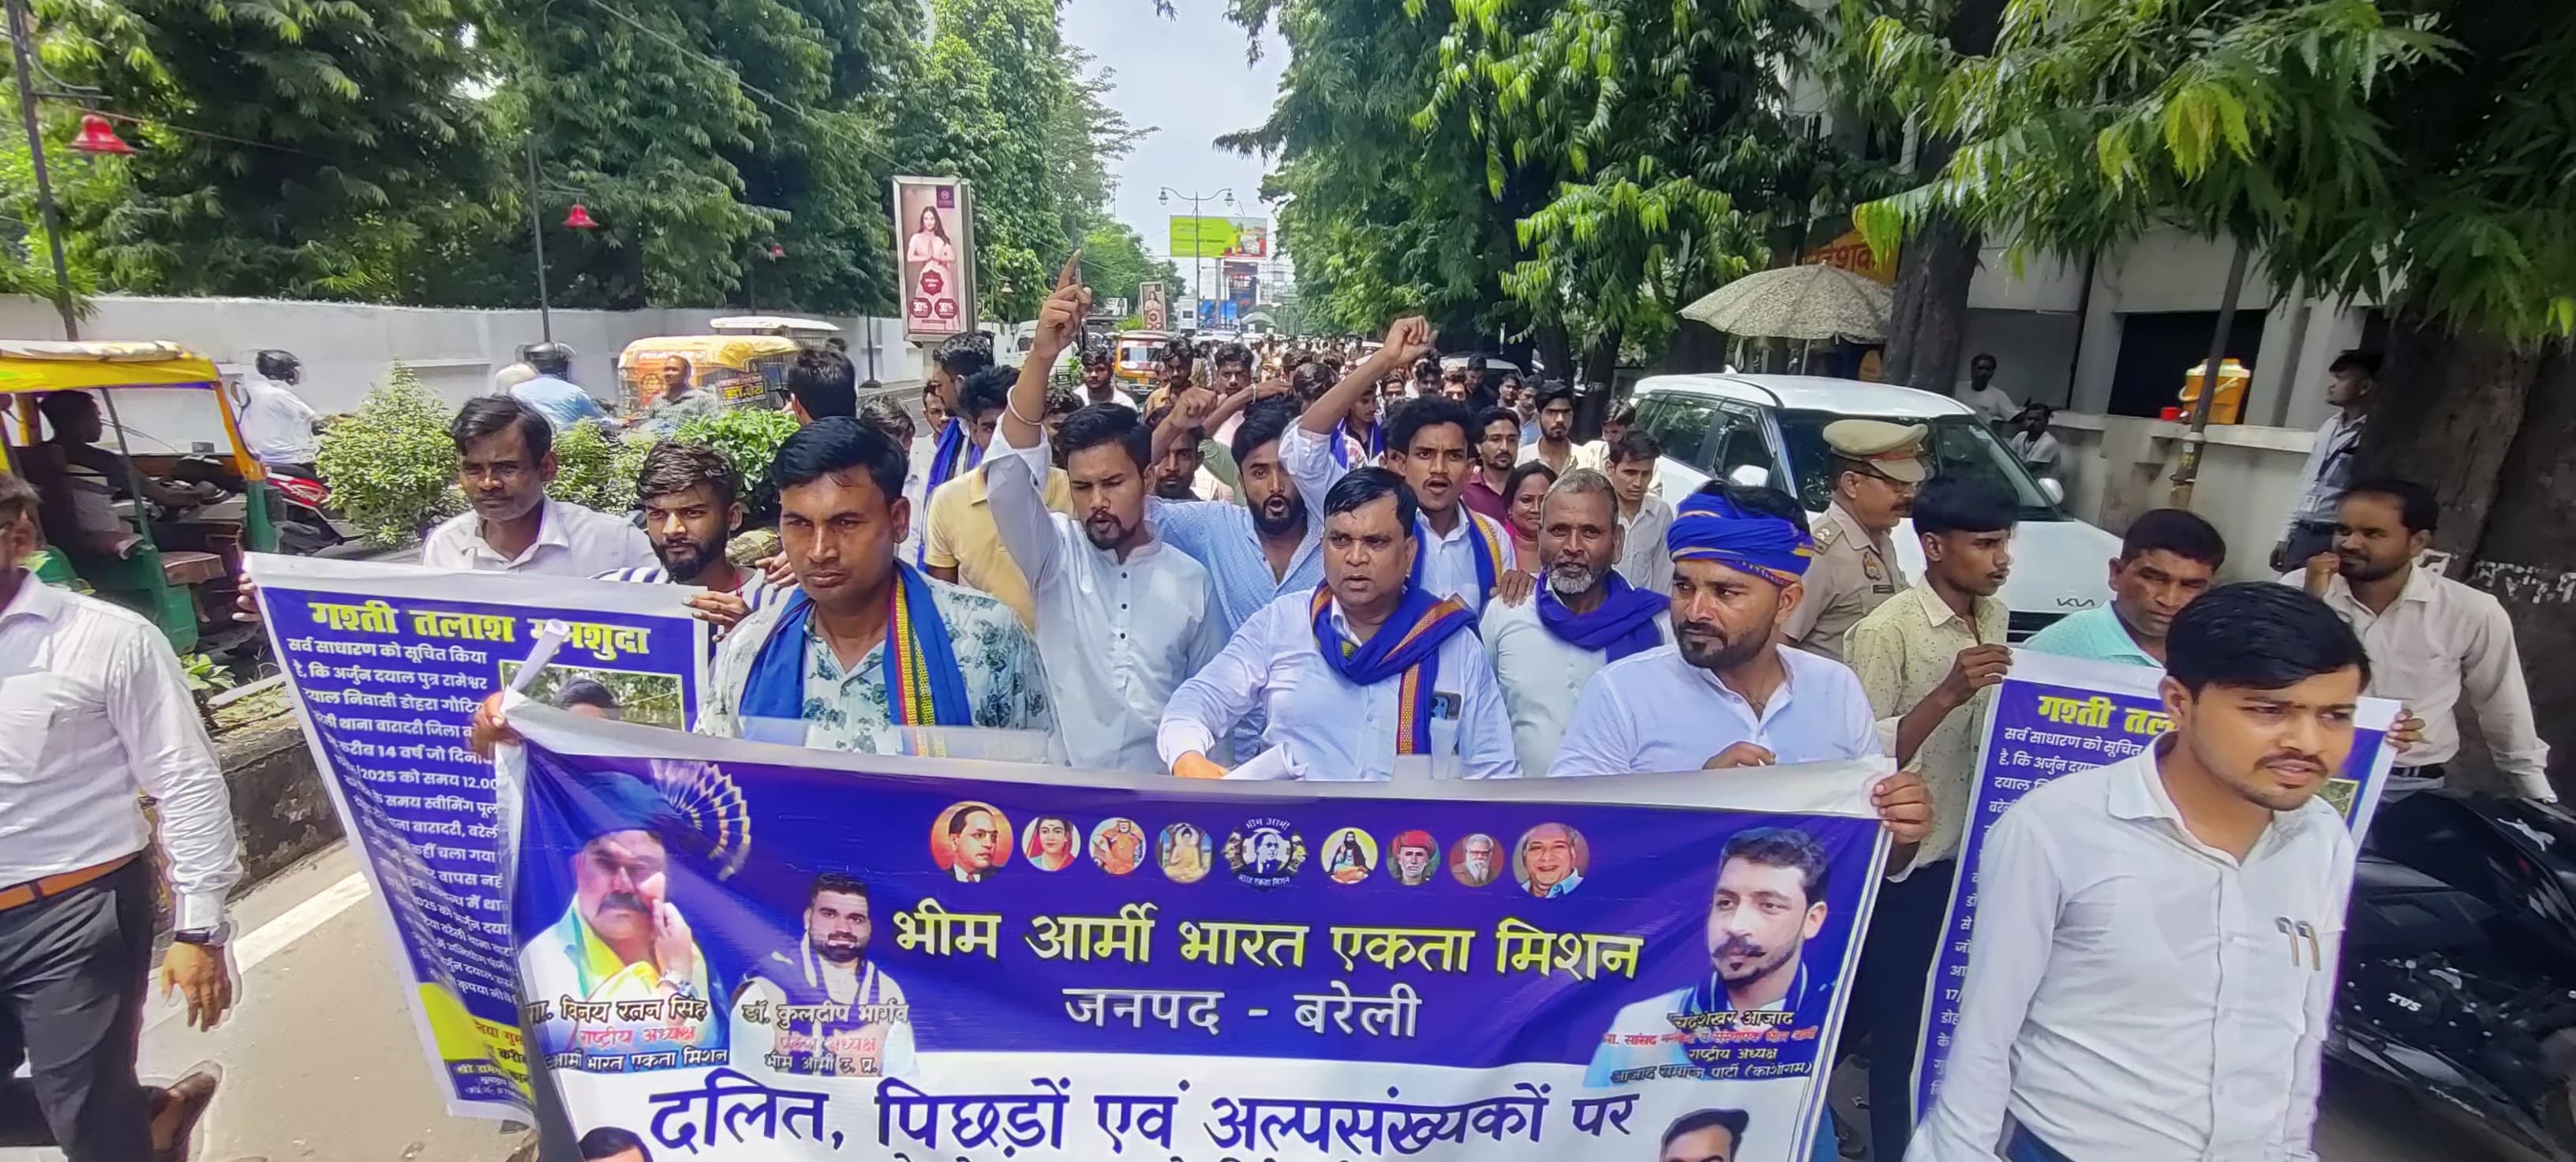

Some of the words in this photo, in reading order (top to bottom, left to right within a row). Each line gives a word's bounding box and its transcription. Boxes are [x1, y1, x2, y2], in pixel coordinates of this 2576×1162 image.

[308, 600, 399, 634] गश्ती
[409, 609, 515, 643] तलाश
[286, 635, 314, 652] सर्व
[316, 638, 377, 657] साधारण
[380, 641, 401, 658] को
[404, 643, 447, 664] सूचित
[448, 645, 488, 665] किया
[309, 662, 331, 679] कि
[334, 665, 372, 685] अर्जुन
[374, 668, 416, 685] दयाल
[417, 672, 440, 690] पुत्र
[343, 688, 398, 709] निवासी
[400, 695, 439, 712] डोहरा
[2038, 695, 2117, 729] गश्ती
[339, 718, 373, 733] थाना
[425, 719, 461, 738] जिला
[2005, 726, 2031, 741] सर्व
[2030, 730, 2081, 749] साधारण
[2083, 736, 2102, 751] को
[378, 745, 397, 758] 14
[399, 744, 426, 760] वर्ष
[426, 745, 447, 763] जो
[2012, 750, 2031, 767] कि
[2033, 755, 2066, 775] अर्जुन
[398, 768, 420, 784] को
[421, 772, 460, 787] समय
[1994, 777, 2031, 791] दयाल
[384, 794, 421, 809] समय
[423, 794, 474, 813] स्वीमिंग
[436, 846, 466, 861] चला
[468, 849, 496, 863] गया
[437, 871, 477, 885] वापस
[893, 897, 1002, 960] भीम
[1024, 901, 1159, 962] आर्मी
[1178, 920, 1311, 969] भारत
[1330, 924, 1475, 973] एकता
[1496, 916, 1646, 981] मिशन
[560, 994, 610, 1023] विनय
[616, 999, 664, 1022] रतन
[668, 992, 709, 1021] सिंह
[776, 999, 851, 1031] कुलदीप
[857, 997, 910, 1025] भार्गव
[1061, 988, 1226, 1036] जनपद
[1293, 980, 1422, 1037] बरेली
[2387, 991, 2423, 1012] TVS
[1741, 1010, 1795, 1027] आजाद
[586, 1051, 624, 1071] भारत
[631, 1050, 677, 1070] एकता
[682, 1044, 729, 1067] मिशन
[1737, 1047, 1778, 1060] अध्यक्ष
[649, 1066, 845, 1154] दलित,
[874, 1076, 1071, 1158] पिछड़ों
[1094, 1079, 1191, 1154] एवं
[1203, 1081, 1552, 1156] अल्पसंख्यकों
[1572, 1093, 1641, 1138] पर
